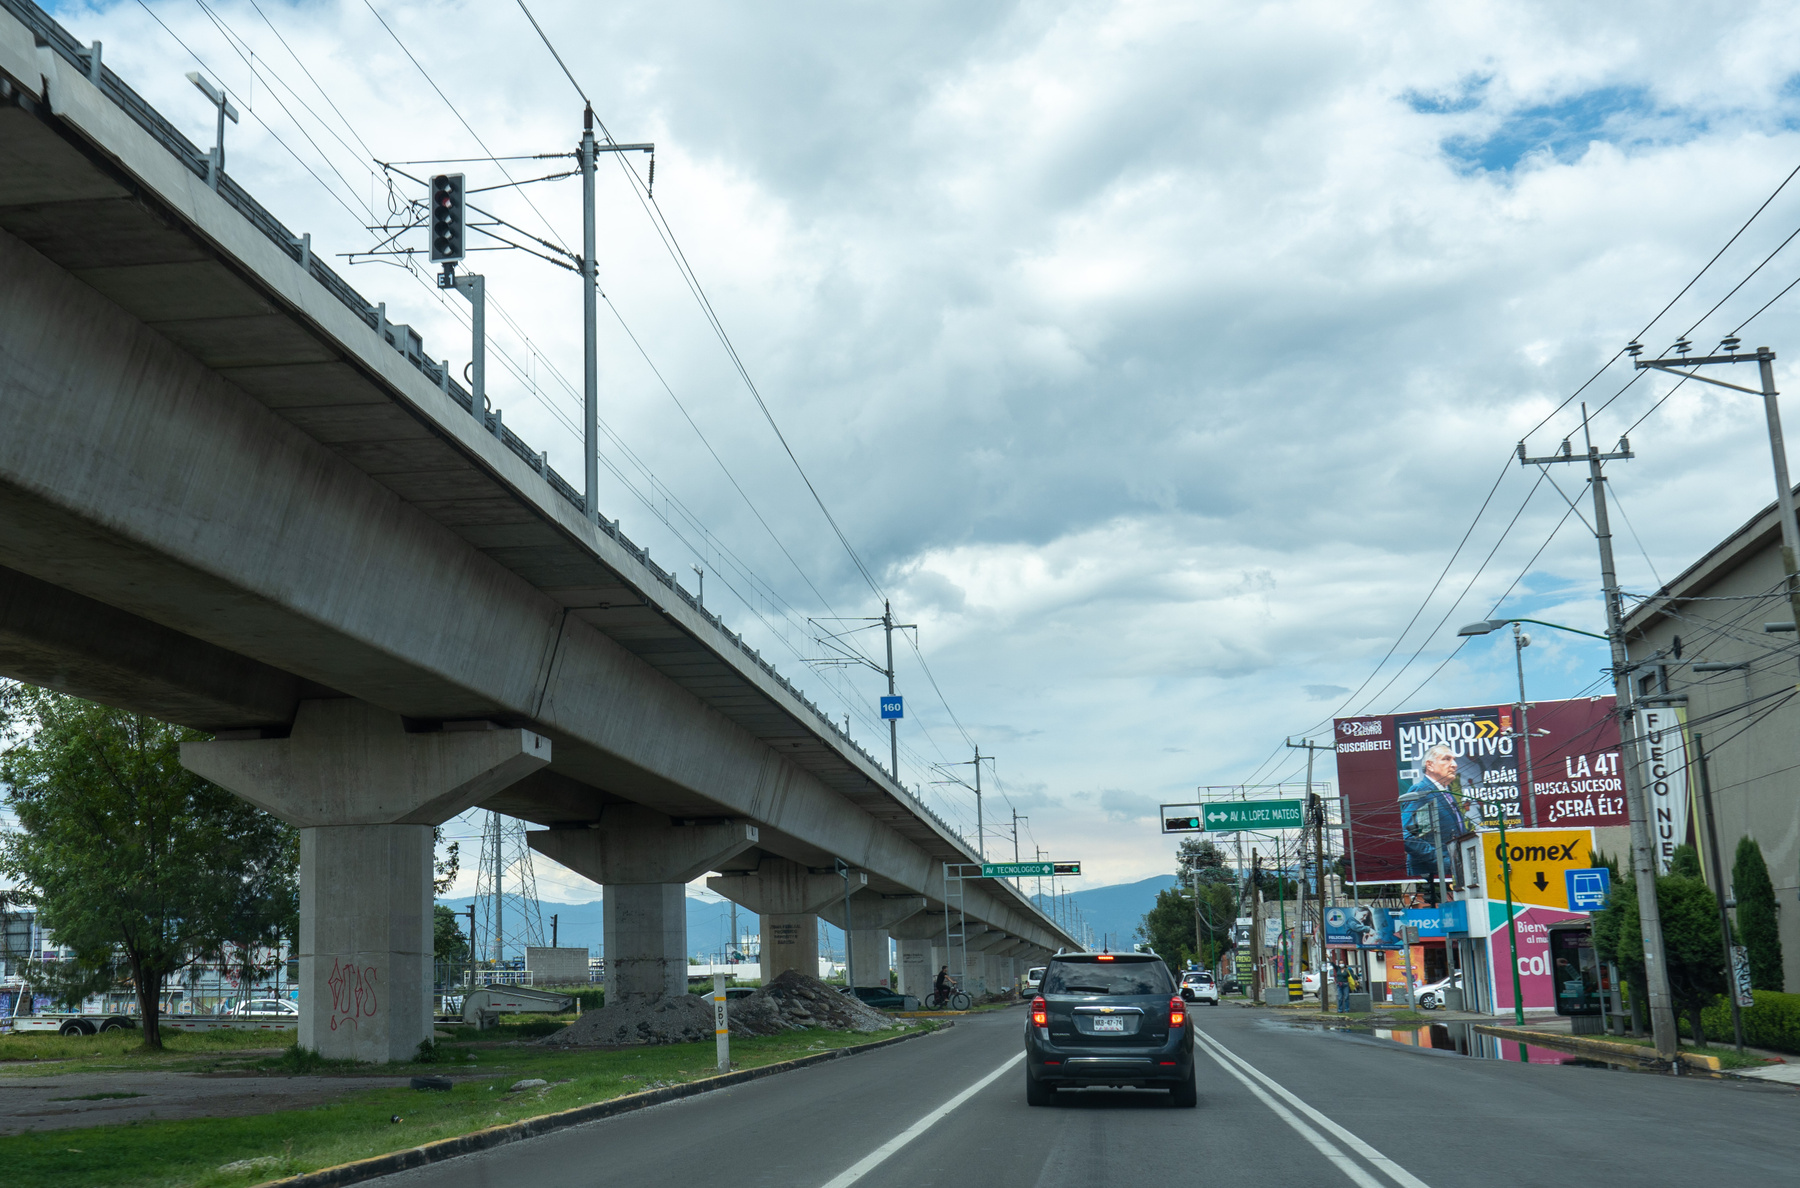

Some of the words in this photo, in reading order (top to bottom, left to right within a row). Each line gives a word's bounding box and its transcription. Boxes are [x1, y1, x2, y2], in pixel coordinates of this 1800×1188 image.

[883, 703, 901, 712] 160
[1398, 721, 1476, 745] MUNDO
[1336, 739, 1392, 753] ¡SUSCRÍBETE!
[1400, 736, 1513, 762] EJUTIVO
[1646, 713, 1669, 797] FUEGO
[1565, 754, 1592, 779] LA
[1594, 752, 1620, 776] 4T
[1483, 766, 1518, 784] ADÁN
[1461, 785, 1519, 802] AUGUSTO
[1534, 781, 1570, 795] BUSCA
[1571, 778, 1622, 793] SUCESOR
[1248, 809, 1270, 821] LOPEZ
[1272, 808, 1300, 820] MATEOS
[1483, 801, 1521, 818] LÓPEZ
[1548, 794, 1596, 823] ¿SERÁ
[1597, 793, 1624, 816] ÉL?
[1495, 838, 1580, 862] Comex
[997, 865, 1040, 874] TECNOLOGICO
[1408, 918, 1440, 930] mex
[1517, 921, 1548, 933] Bienv
[1526, 934, 1536, 944] al
[1536, 936, 1549, 944] mu
[1517, 949, 1551, 976] col
